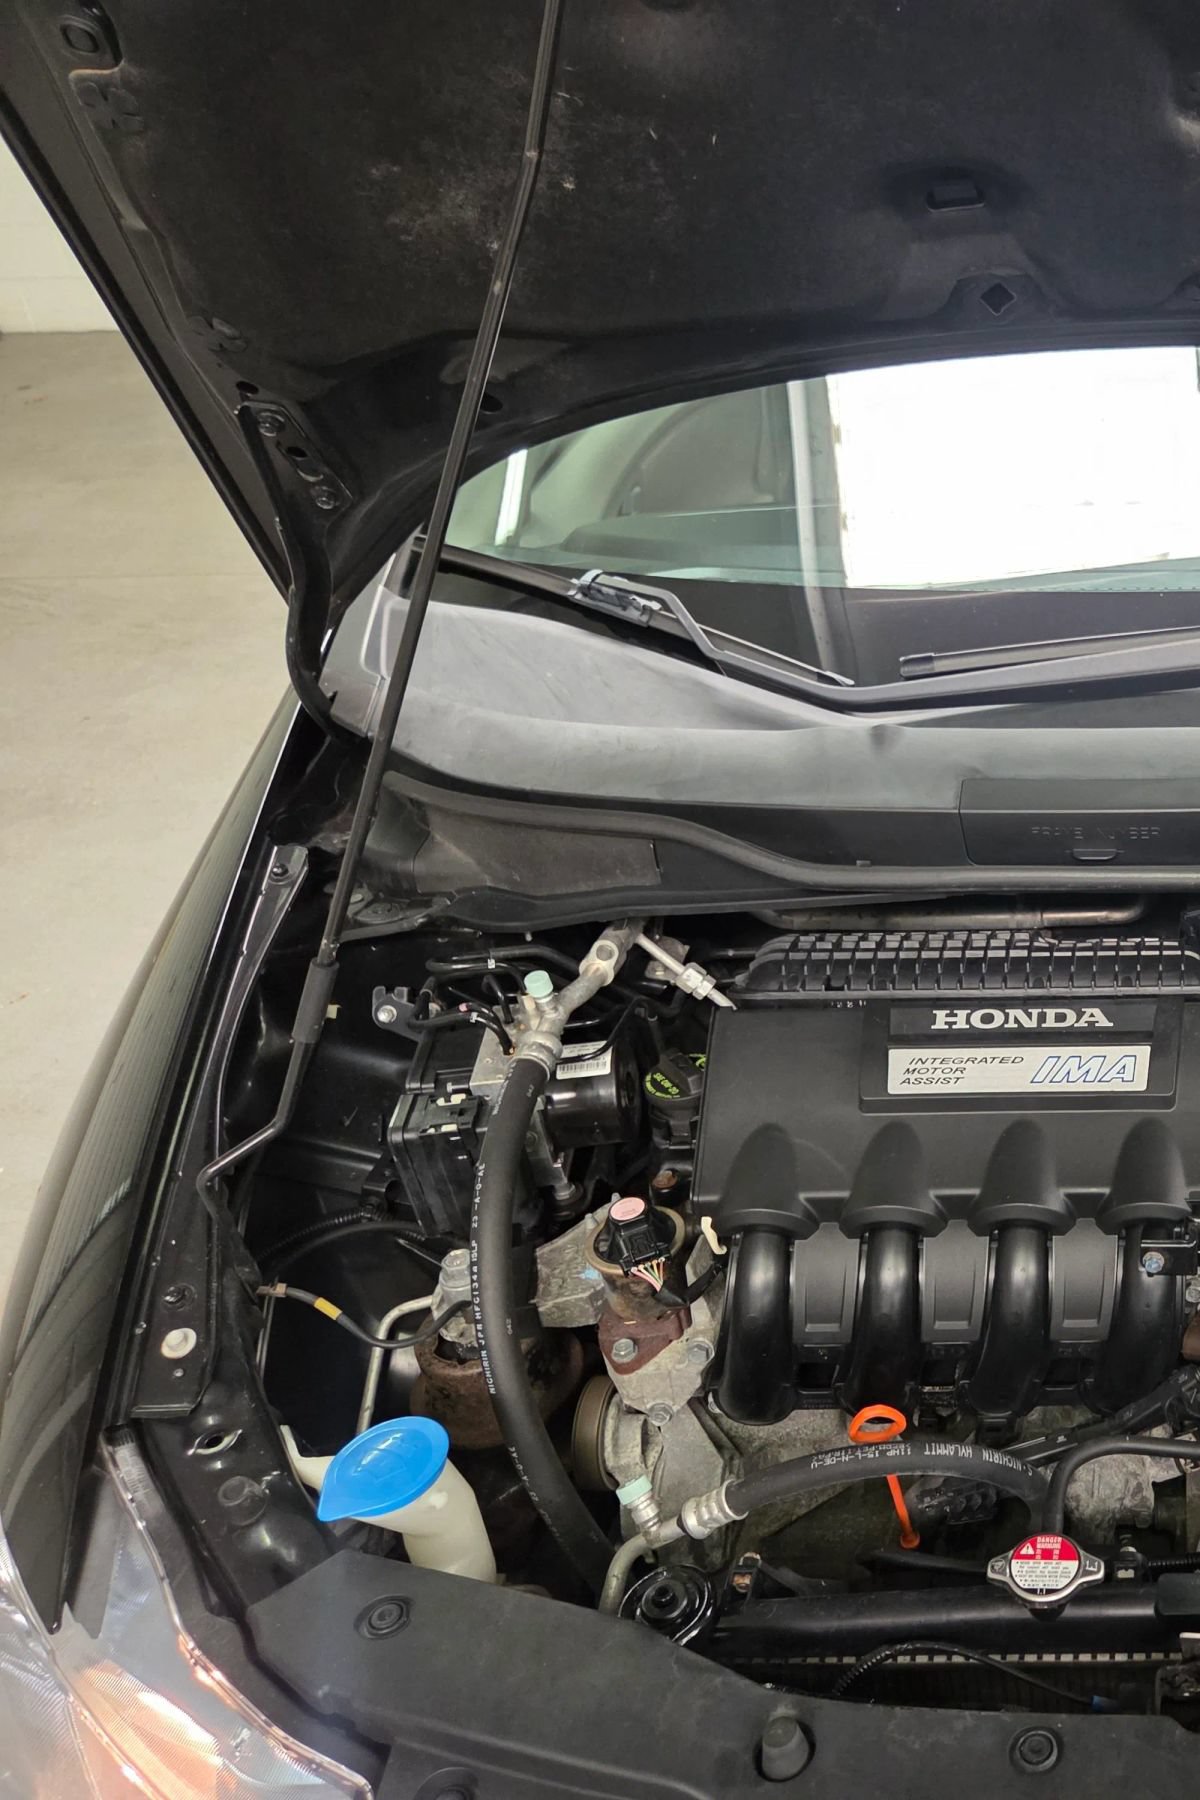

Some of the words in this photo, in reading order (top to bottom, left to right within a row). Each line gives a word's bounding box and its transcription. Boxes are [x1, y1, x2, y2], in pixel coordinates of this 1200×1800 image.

[930, 1007, 1114, 1030] HONDA
[908, 1056, 1025, 1066] INTEGRATED
[902, 1067, 967, 1075] MOTOR
[1030, 1054, 1138, 1084] IMA
[899, 1077, 965, 1086] ASSIST
